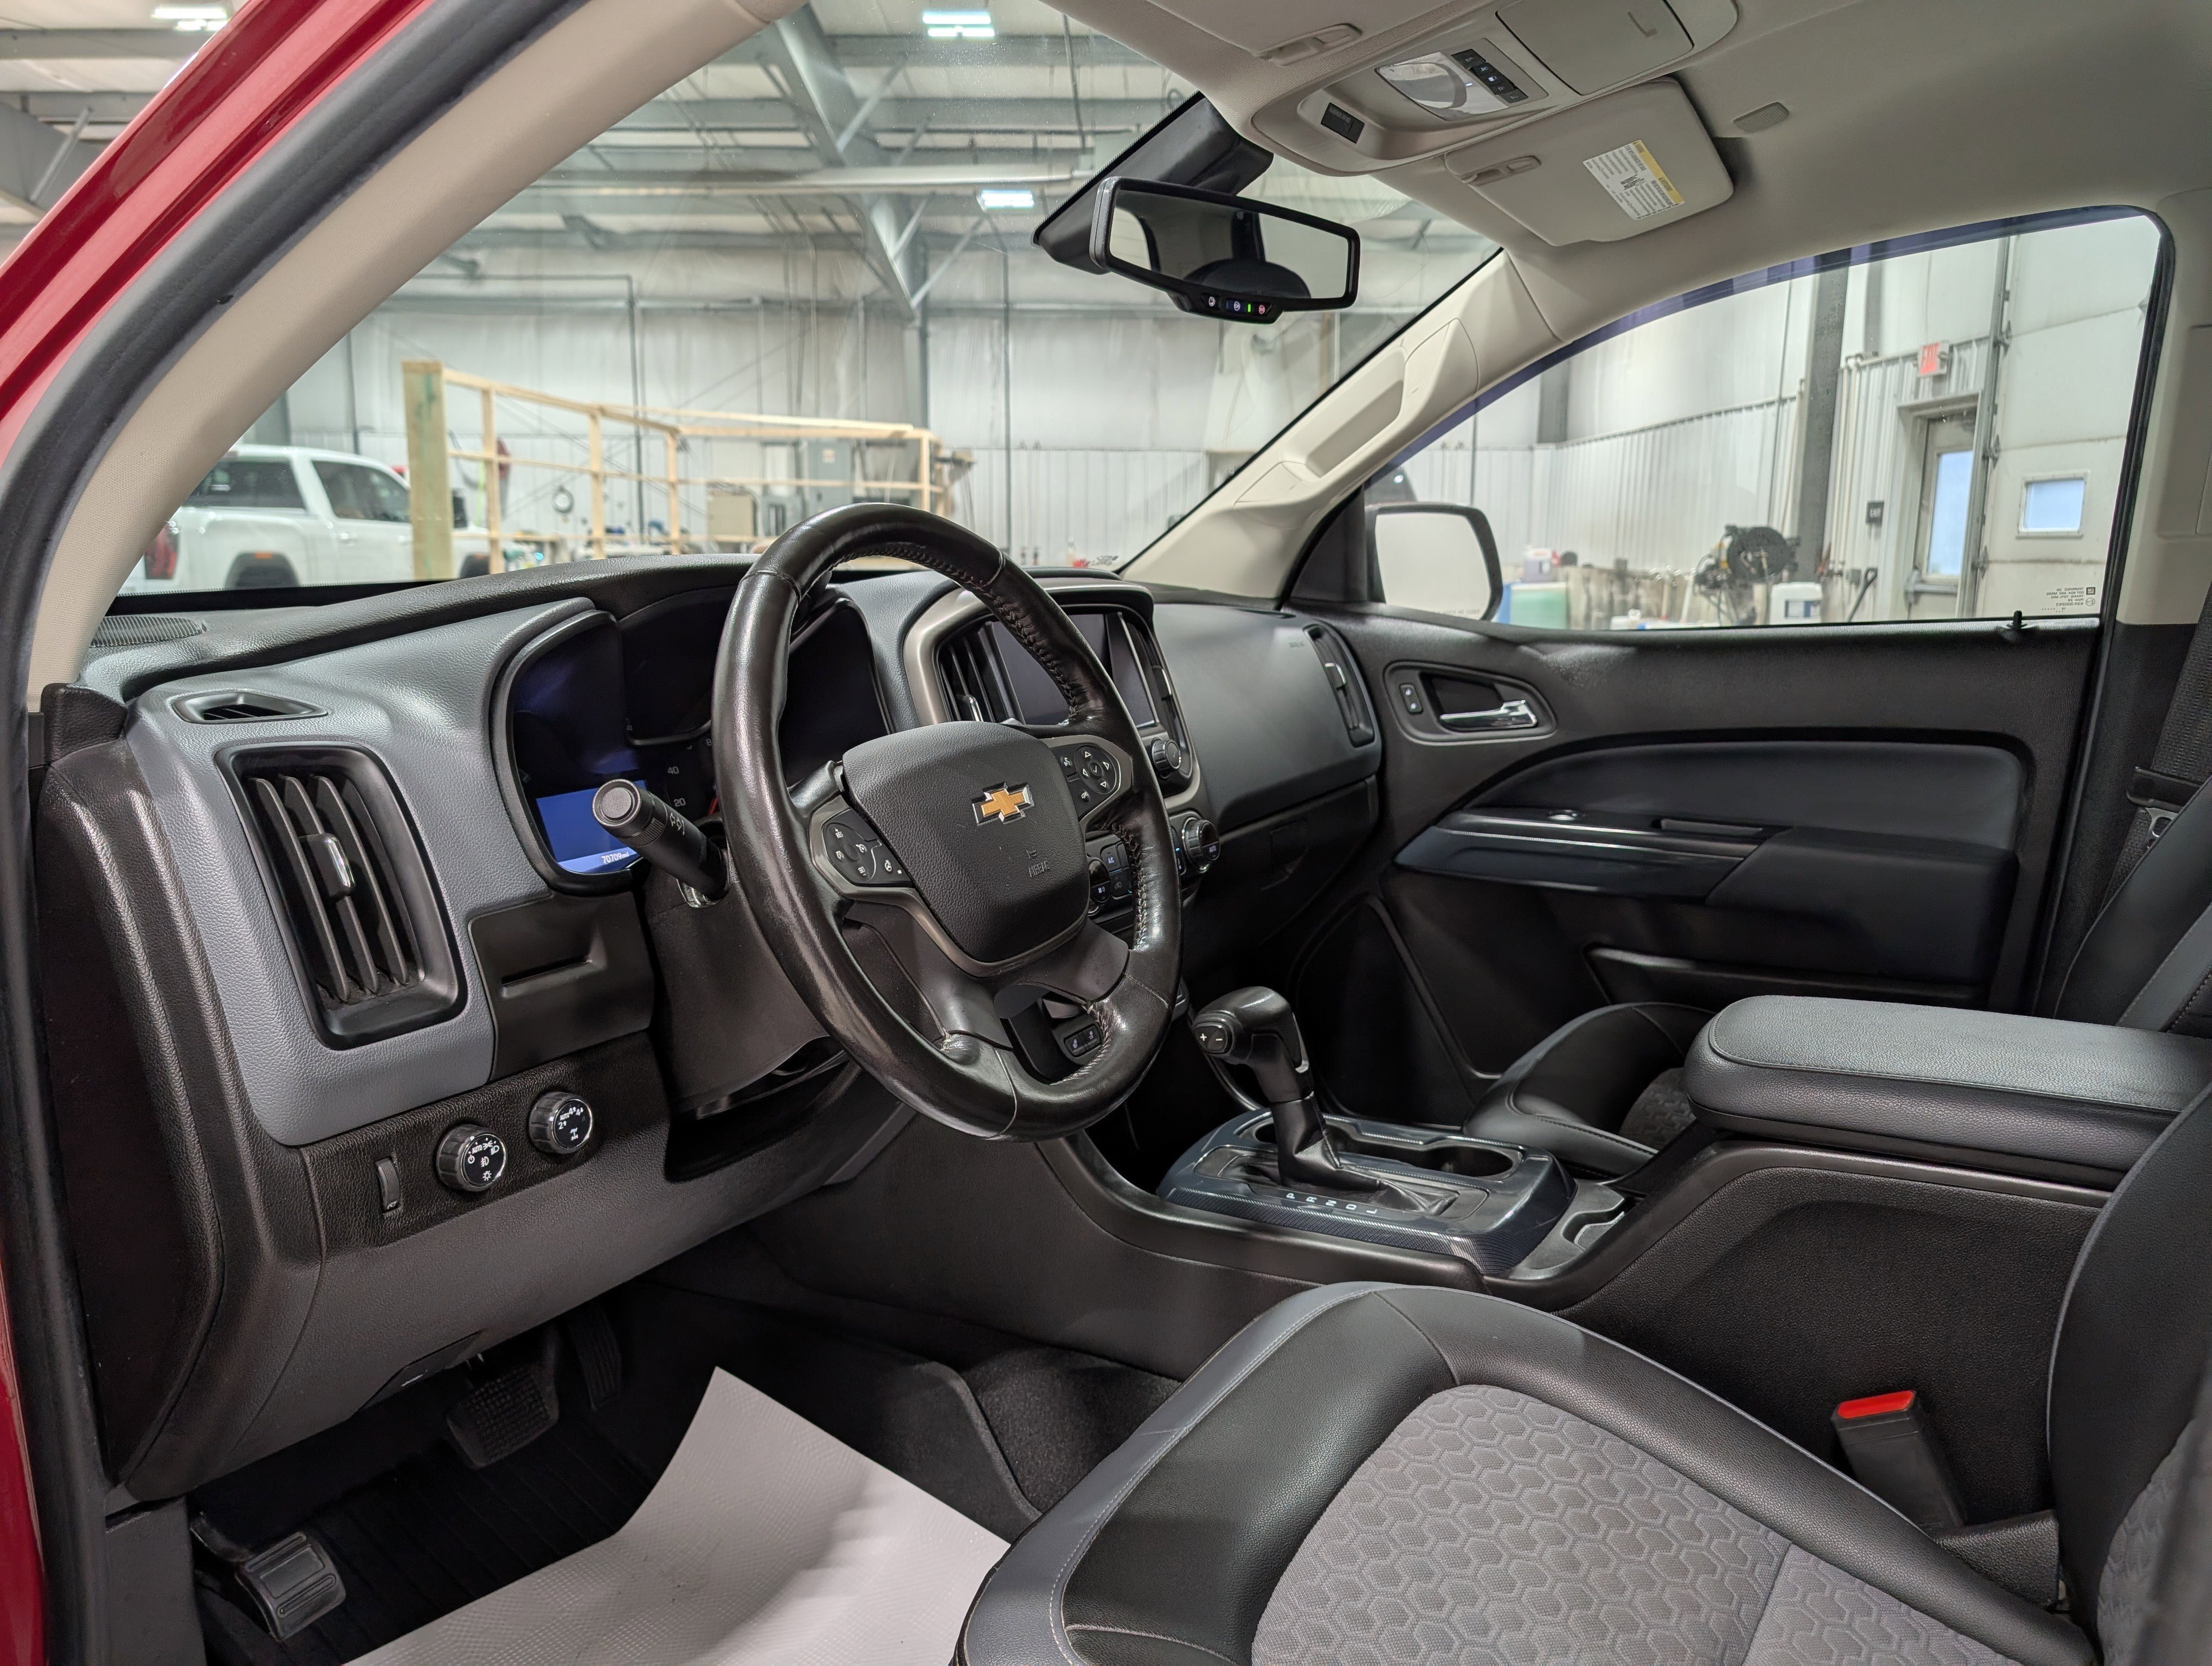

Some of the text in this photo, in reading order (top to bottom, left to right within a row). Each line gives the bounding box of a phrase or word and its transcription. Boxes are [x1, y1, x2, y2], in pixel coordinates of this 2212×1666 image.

[667, 766, 679, 774] 40
[674, 798, 686, 807] 20
[560, 1112, 570, 1121] AUTO
[472, 1144, 483, 1155] AUTO
